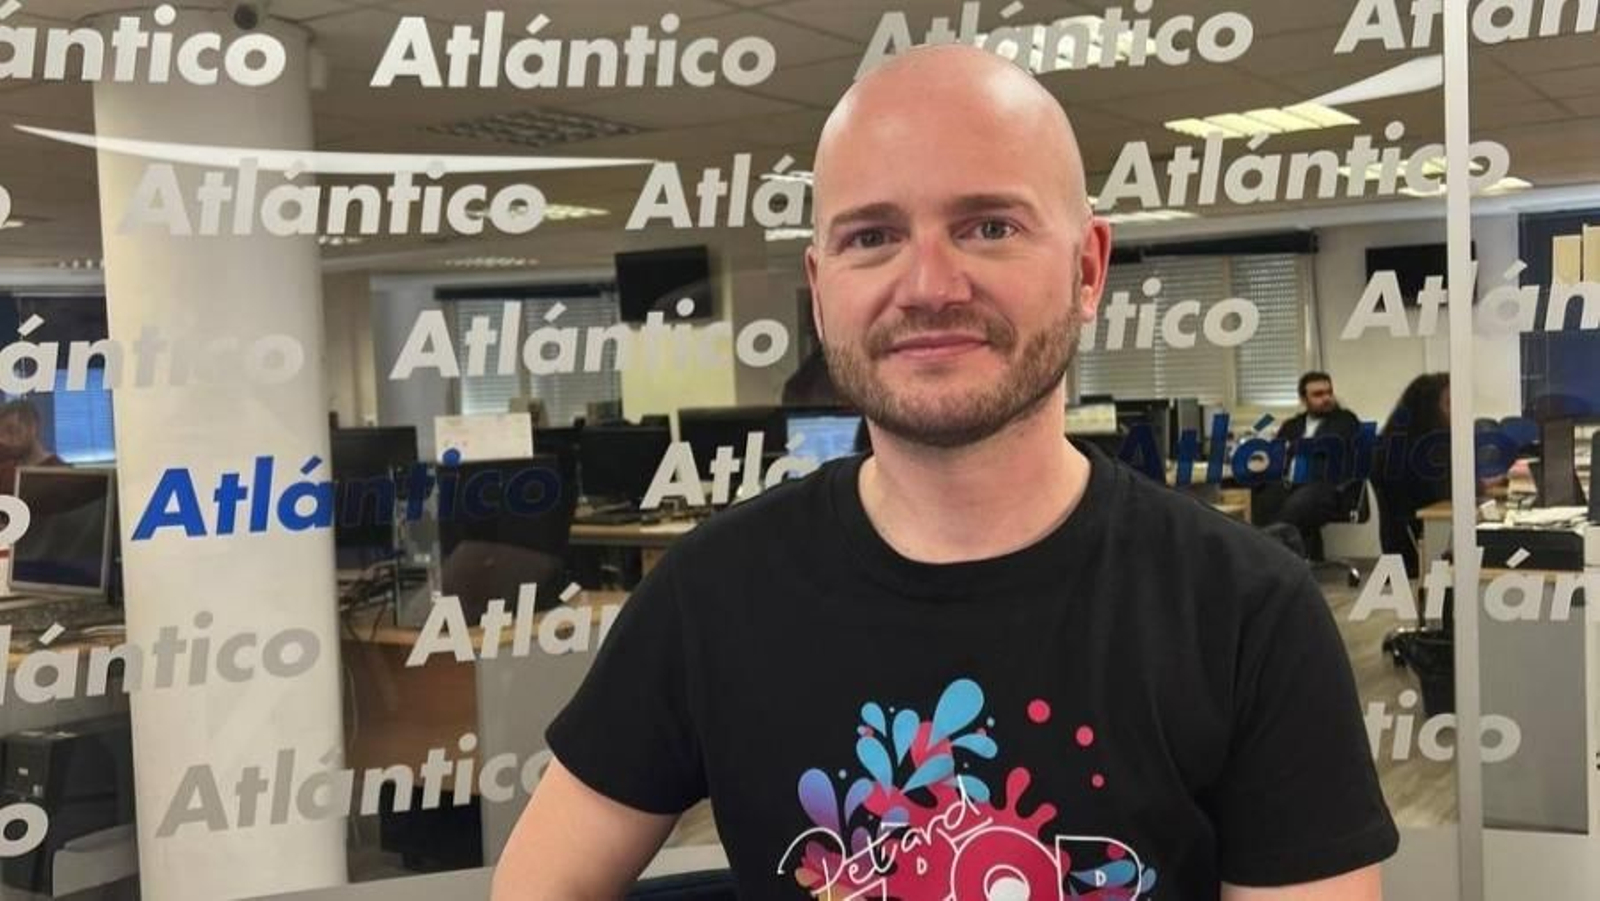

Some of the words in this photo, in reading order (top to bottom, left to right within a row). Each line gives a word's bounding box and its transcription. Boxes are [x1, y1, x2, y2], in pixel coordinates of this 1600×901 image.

[370, 11, 776, 89] Atlántico
[117, 158, 547, 236] Atlántico
[625, 153, 814, 230] Atlá
[1099, 121, 1510, 210] Atlántico
[389, 298, 789, 380] Atlántico
[131, 449, 562, 541] Atlántico
